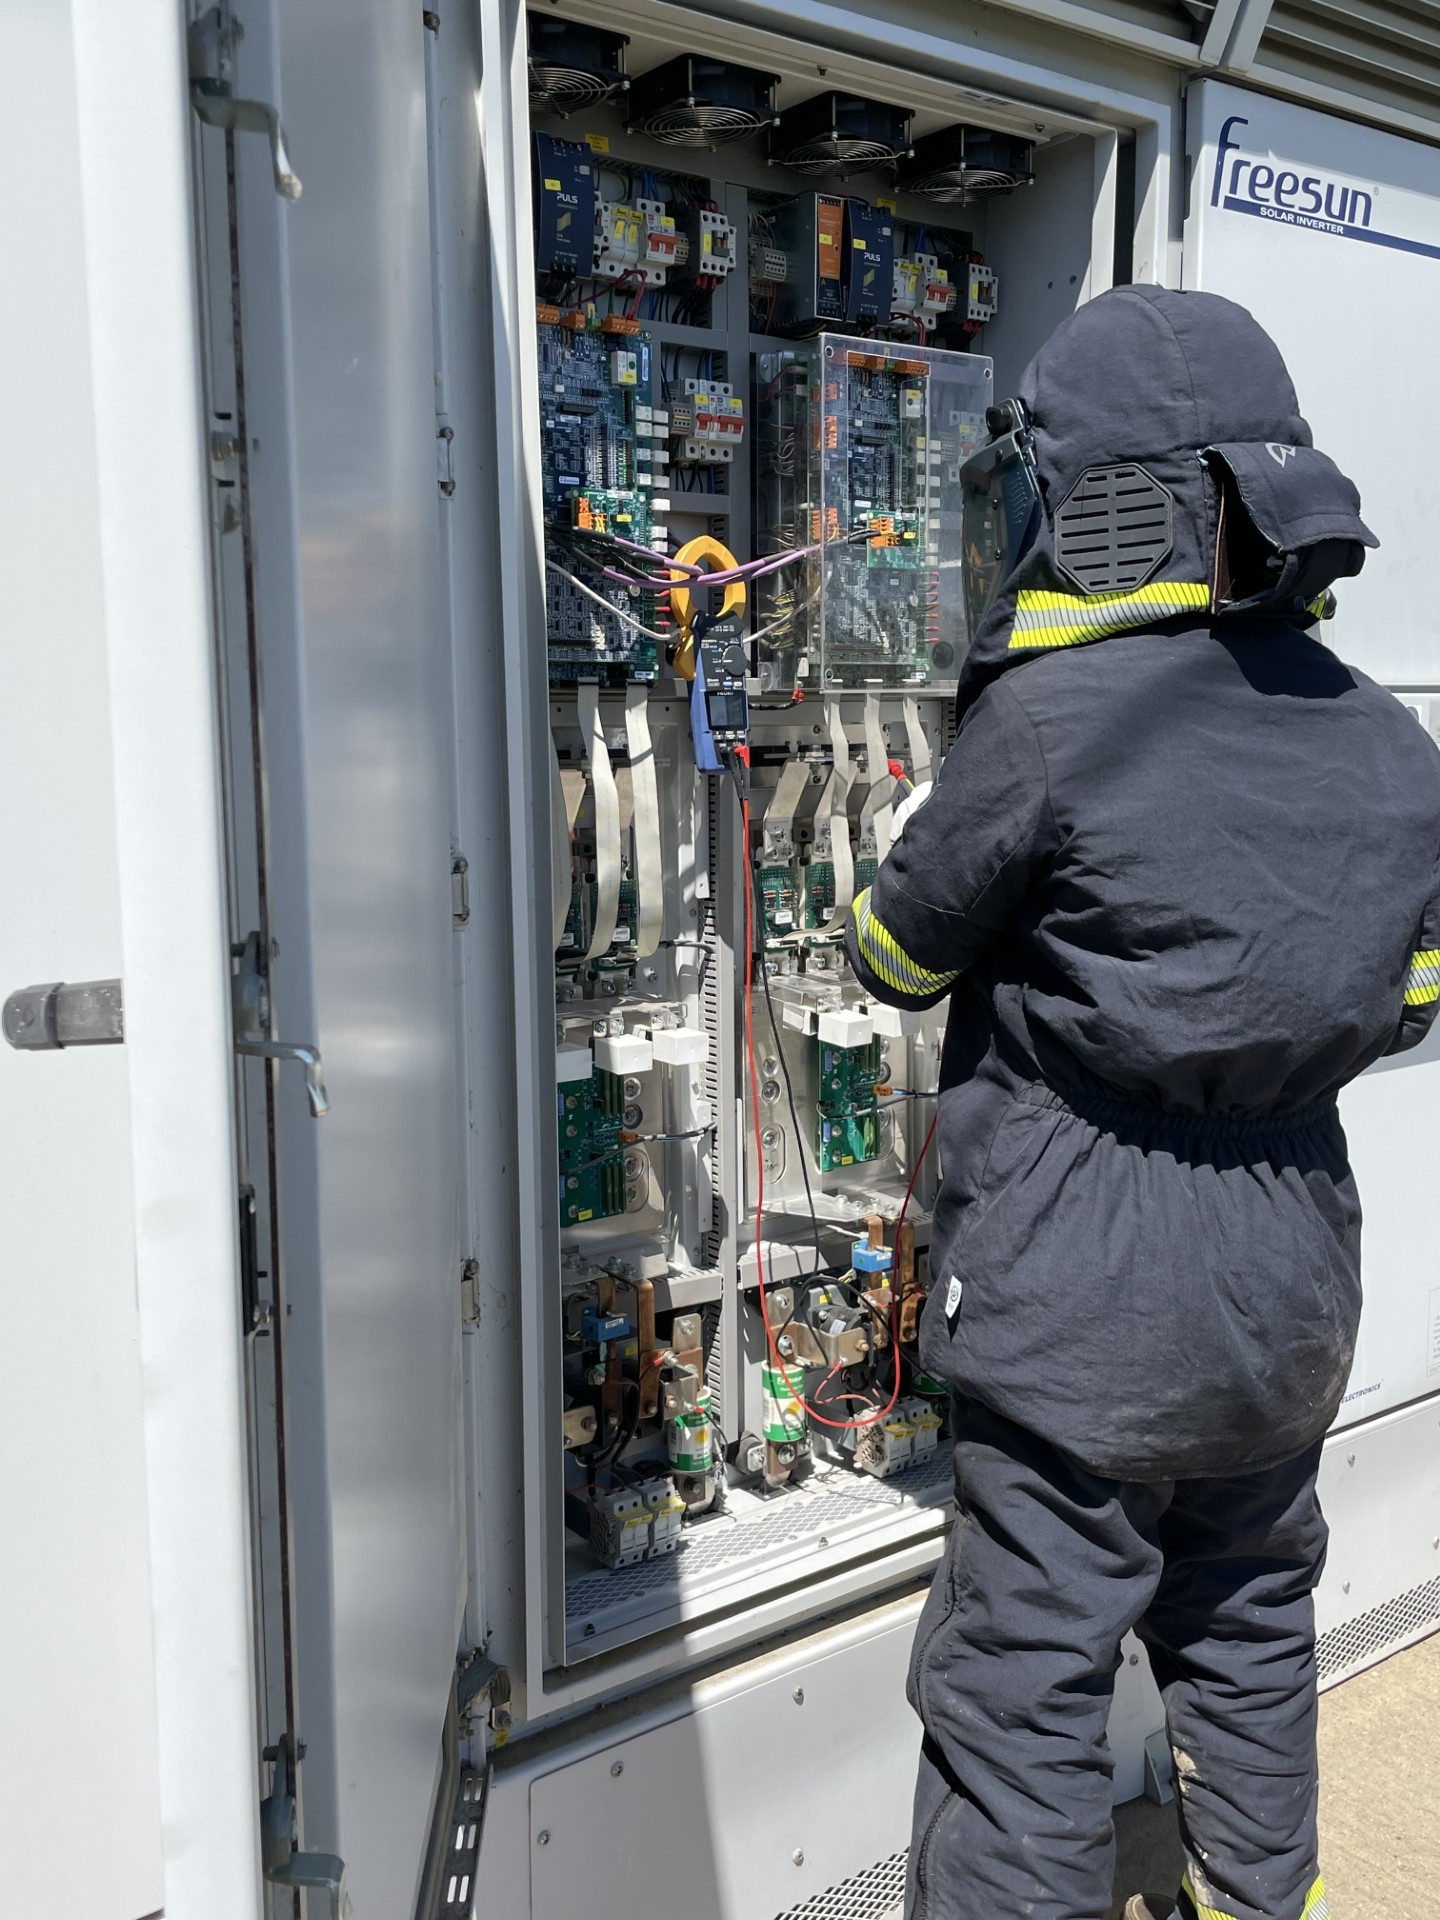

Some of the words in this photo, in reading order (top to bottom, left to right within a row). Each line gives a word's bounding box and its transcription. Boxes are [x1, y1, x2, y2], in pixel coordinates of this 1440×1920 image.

[1210, 116, 1372, 227] freesun
[556, 192, 578, 204] PULS
[1260, 206, 1295, 223] SOLAR
[1296, 215, 1344, 234] INVERTER
[863, 251, 881, 262] PULS
[1340, 1382, 1382, 1404] ELECTRONICS
